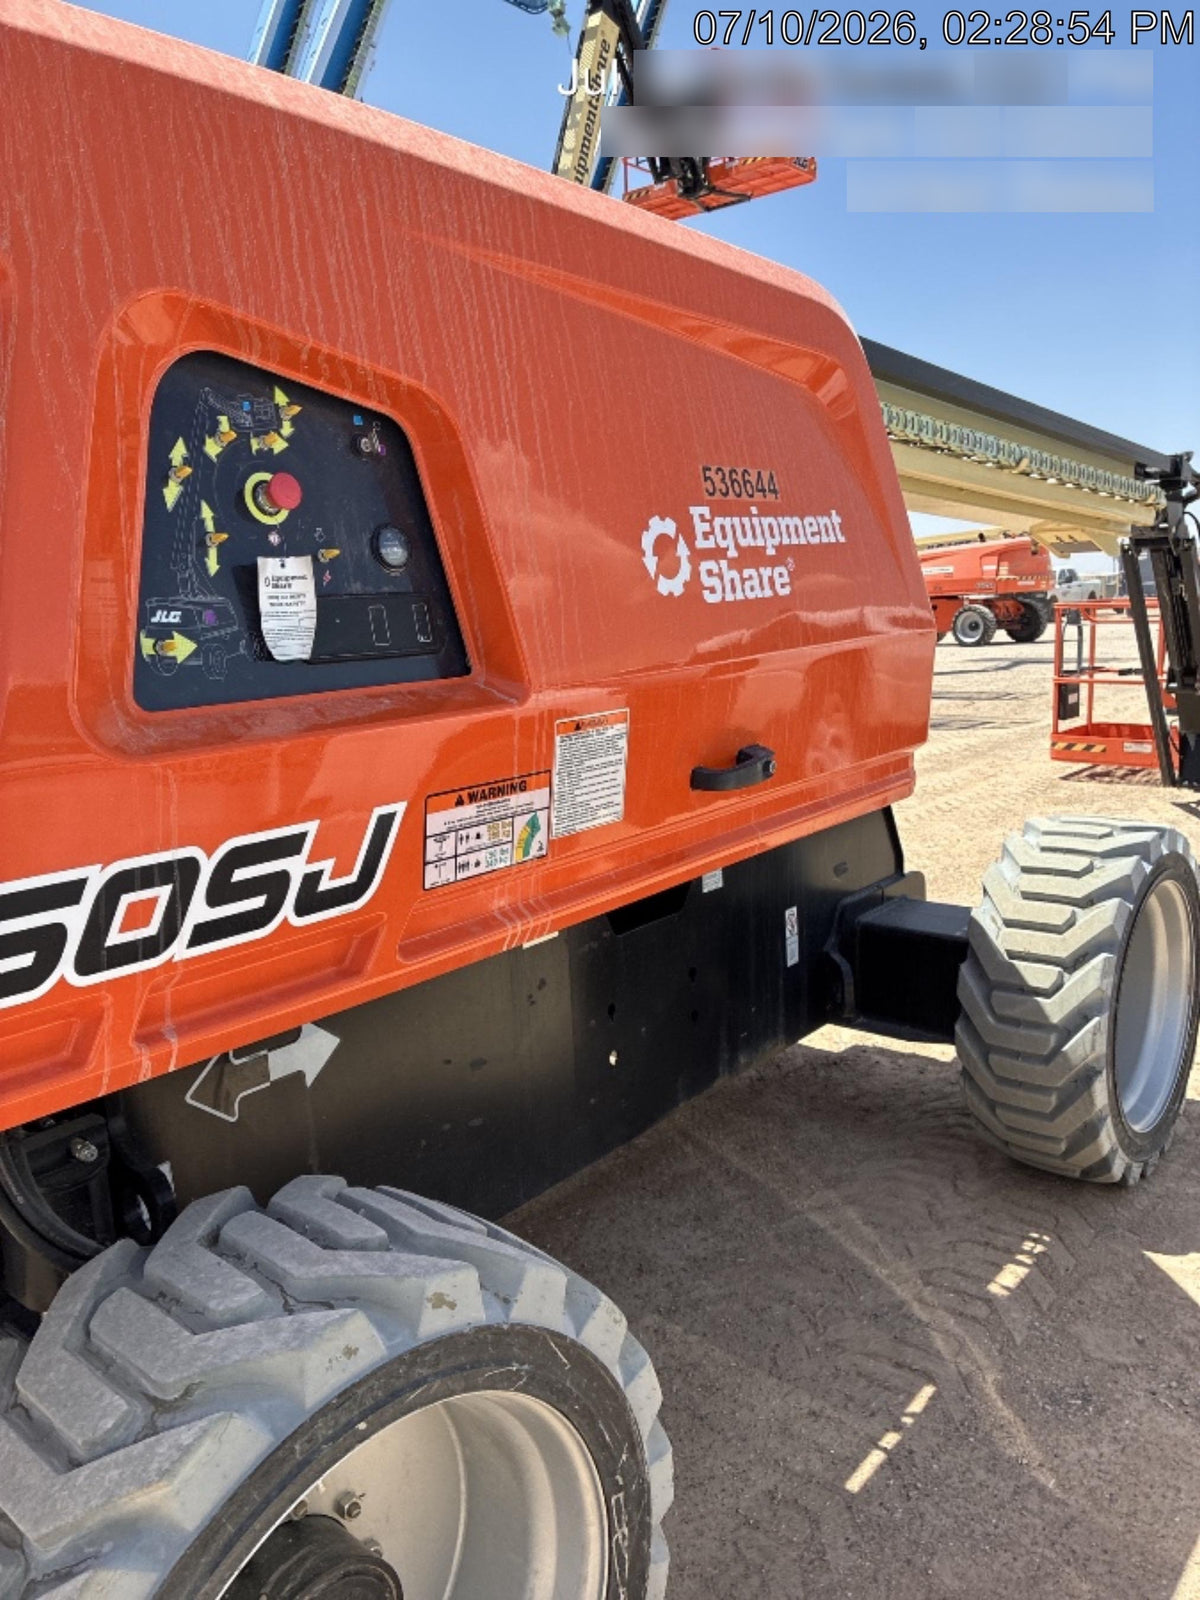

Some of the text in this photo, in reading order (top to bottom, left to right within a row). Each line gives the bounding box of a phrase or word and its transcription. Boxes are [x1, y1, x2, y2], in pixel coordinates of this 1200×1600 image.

[702, 466, 779, 499] 536644
[688, 506, 847, 559] Equipment
[150, 610, 182, 623] JLG
[467, 780, 527, 803] WARNING
